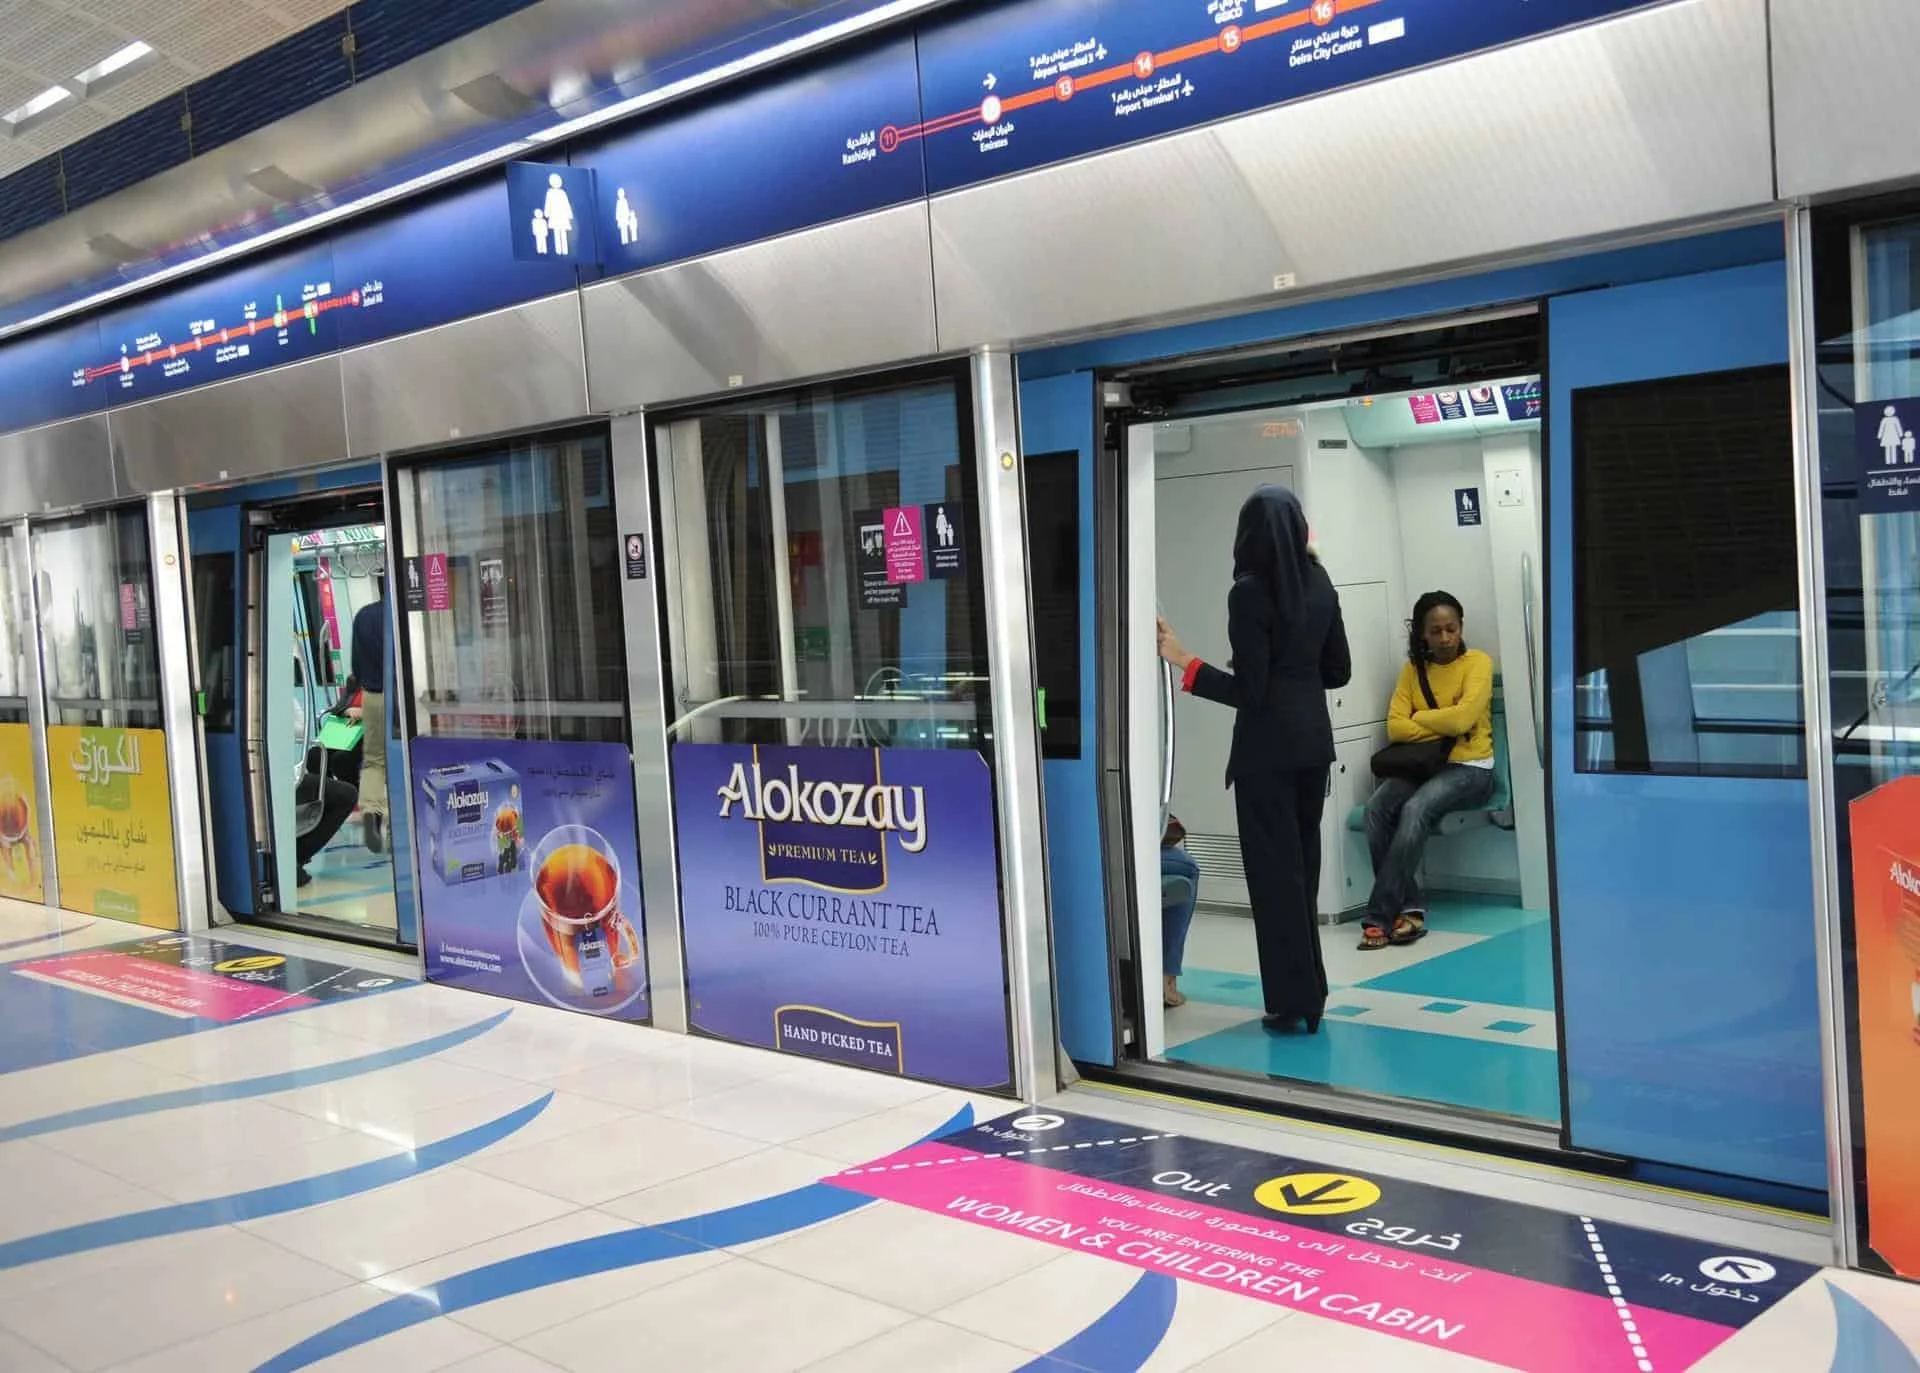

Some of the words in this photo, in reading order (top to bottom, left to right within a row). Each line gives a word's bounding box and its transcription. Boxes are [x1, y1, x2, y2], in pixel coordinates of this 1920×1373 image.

[1314, 3, 1330, 19] 16
[1223, 31, 1238, 48] 15
[1289, 48, 1312, 67] Deira
[1313, 44, 1332, 62] City
[1332, 38, 1363, 56] Centre
[1033, 63, 1059, 80] Airport
[1058, 54, 1088, 73] Terminal
[1136, 56, 1153, 73] 14
[1058, 80, 1073, 97] 13
[1114, 99, 1142, 117] Airport
[1142, 90, 1174, 109] Terminal
[883, 131, 894, 146] 11
[70, 734, 142, 785] الكوزي
[447, 791, 489, 811] Alokozay
[717, 762, 928, 853] Alokozay
[777, 844, 836, 863] PREMIUM
[839, 848, 868, 865] TEA
[724, 885, 788, 918] BLACK
[787, 891, 893, 931] CURRANT
[895, 904, 941, 936] TEA
[753, 921, 781, 939] 100%
[783, 924, 819, 946] PURE
[820, 929, 878, 954] CEYLON
[880, 936, 911, 958] TEA
[783, 1022, 818, 1043] HAND
[820, 1028, 866, 1053] PICKED
[867, 1036, 893, 1058] TEA
[1152, 1170, 1233, 1197] Out
[1205, 1216, 1291, 1243] مقصورة
[1345, 1217, 1463, 1251] خروج
[1099, 1215, 1139, 1233] YOU
[1137, 1226, 1178, 1243] ARE
[1176, 1236, 1277, 1268] ENTERING
[1275, 1259, 1326, 1278] THE
[945, 1195, 1086, 1241] WOMEN
[1080, 1231, 1116, 1249] &
[1116, 1240, 1319, 1302] CHILDREN
[1319, 1291, 1466, 1342] CABIN
[1347, 1251, 1414, 1270] تدخل
[1658, 1273, 1683, 1286] In
[1690, 1281, 1761, 1304] دخول
